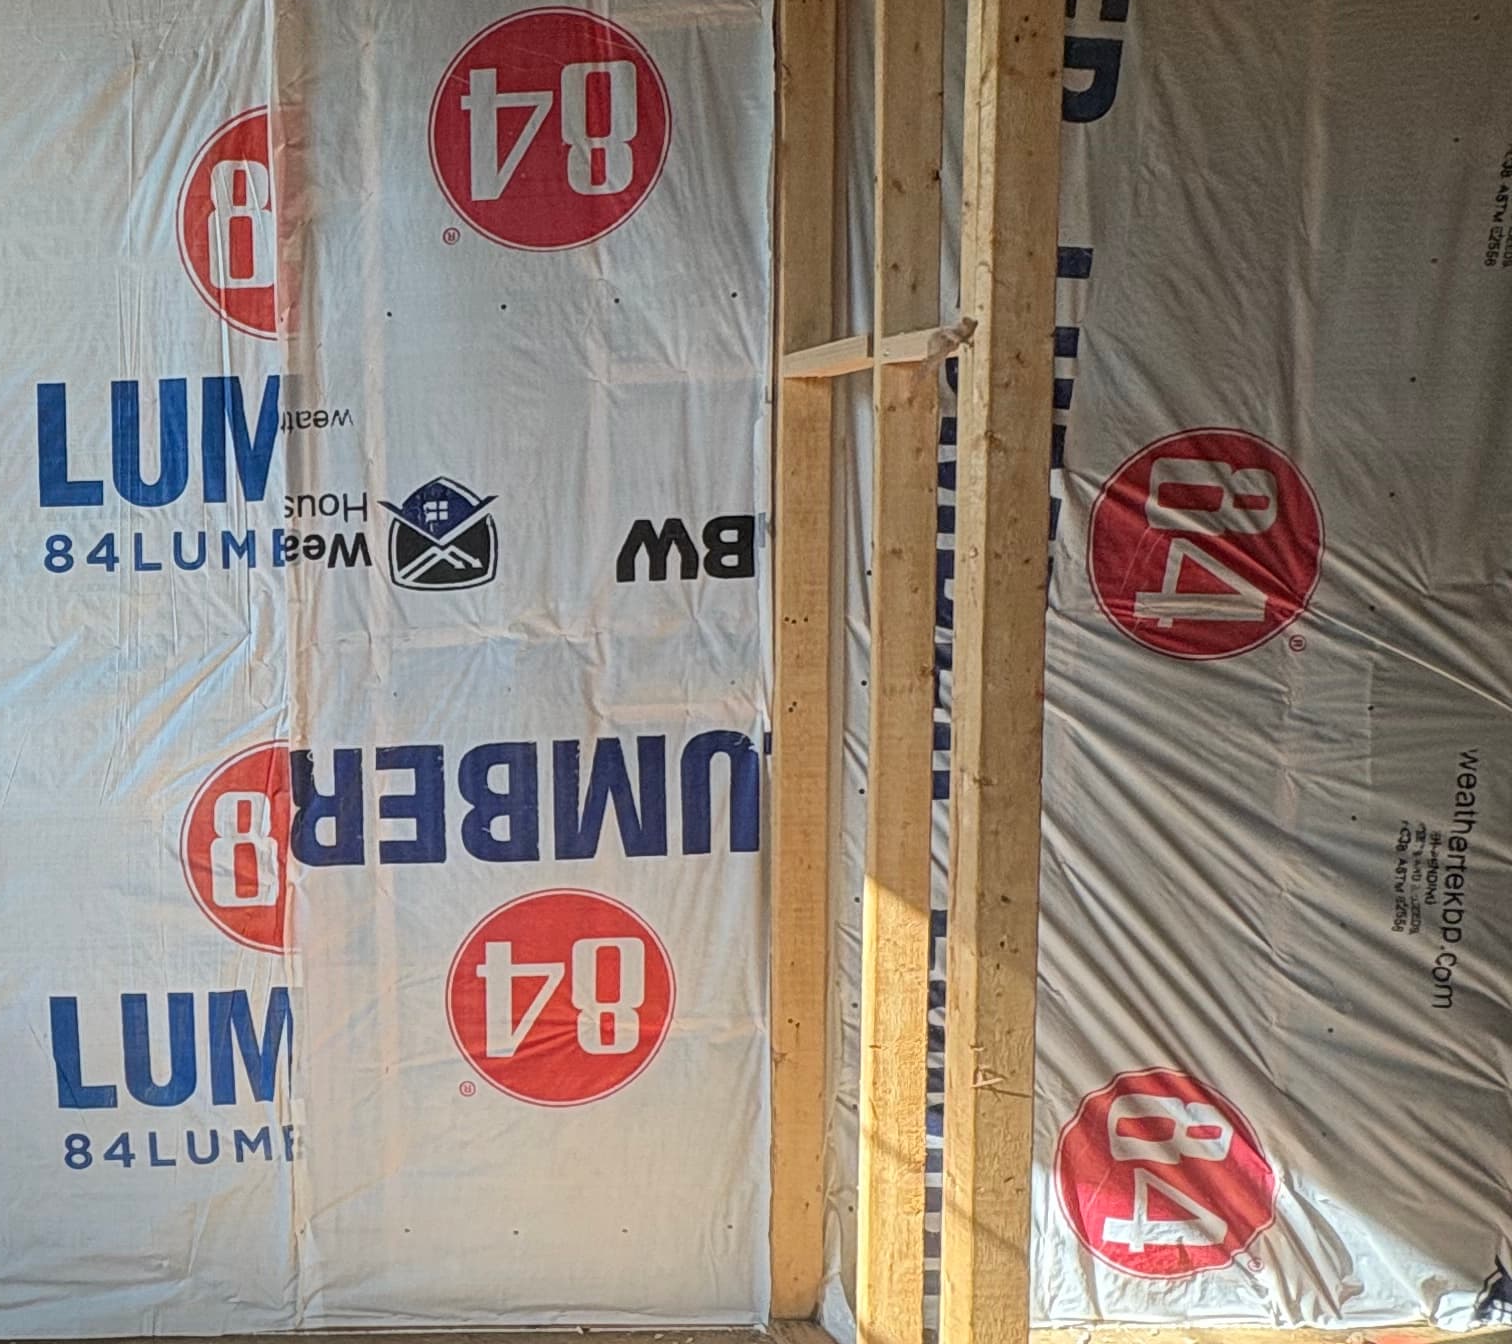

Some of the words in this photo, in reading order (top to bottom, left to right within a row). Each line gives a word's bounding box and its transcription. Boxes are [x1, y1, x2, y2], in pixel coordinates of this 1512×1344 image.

[460, 59, 639, 201] 84
[616, 513, 756, 584] BW
[1134, 458, 1279, 629] 84
[209, 792, 280, 908] 8
[290, 730, 771, 867] UMBER
[1393, 858, 1409, 893] ASTM
[1431, 749, 1481, 1010] weathertekbp.com
[476, 936, 645, 1057] 84
[1103, 1093, 1234, 1253] 84
